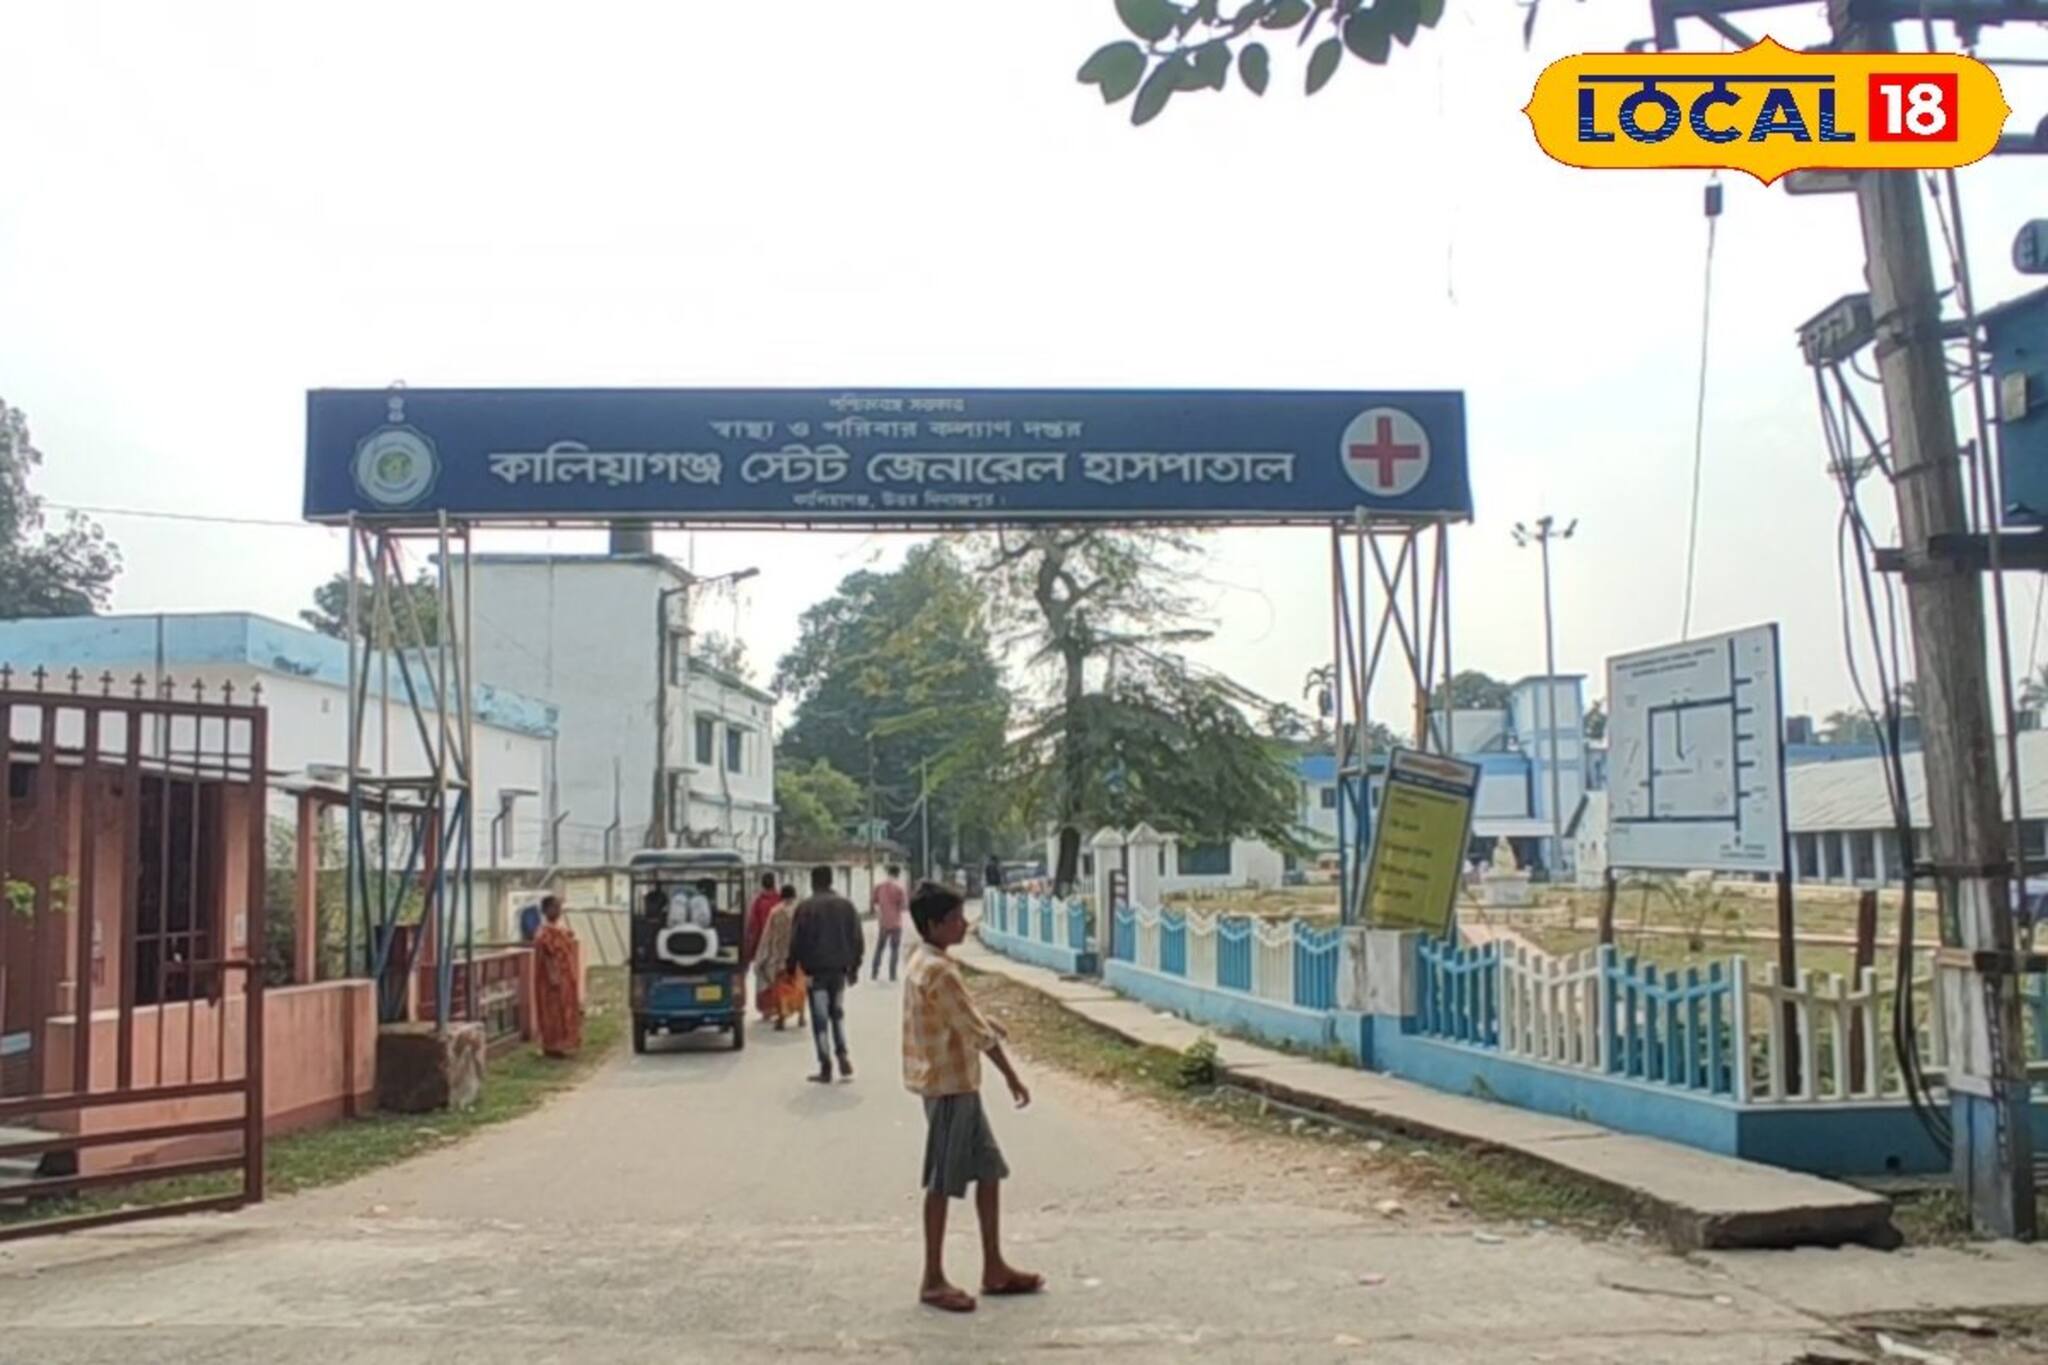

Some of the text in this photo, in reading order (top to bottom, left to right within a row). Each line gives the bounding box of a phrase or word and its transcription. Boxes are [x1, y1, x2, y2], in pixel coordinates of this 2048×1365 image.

[787, 421, 810, 437] ও
[822, 415, 918, 437] পরিবার
[928, 420, 1011, 438] কল্যাণ
[489, 441, 722, 485] কালিয়াগঞ্জ
[866, 452, 1067, 483] জেনারেল
[1081, 452, 1295, 483] হাসপাতাল
